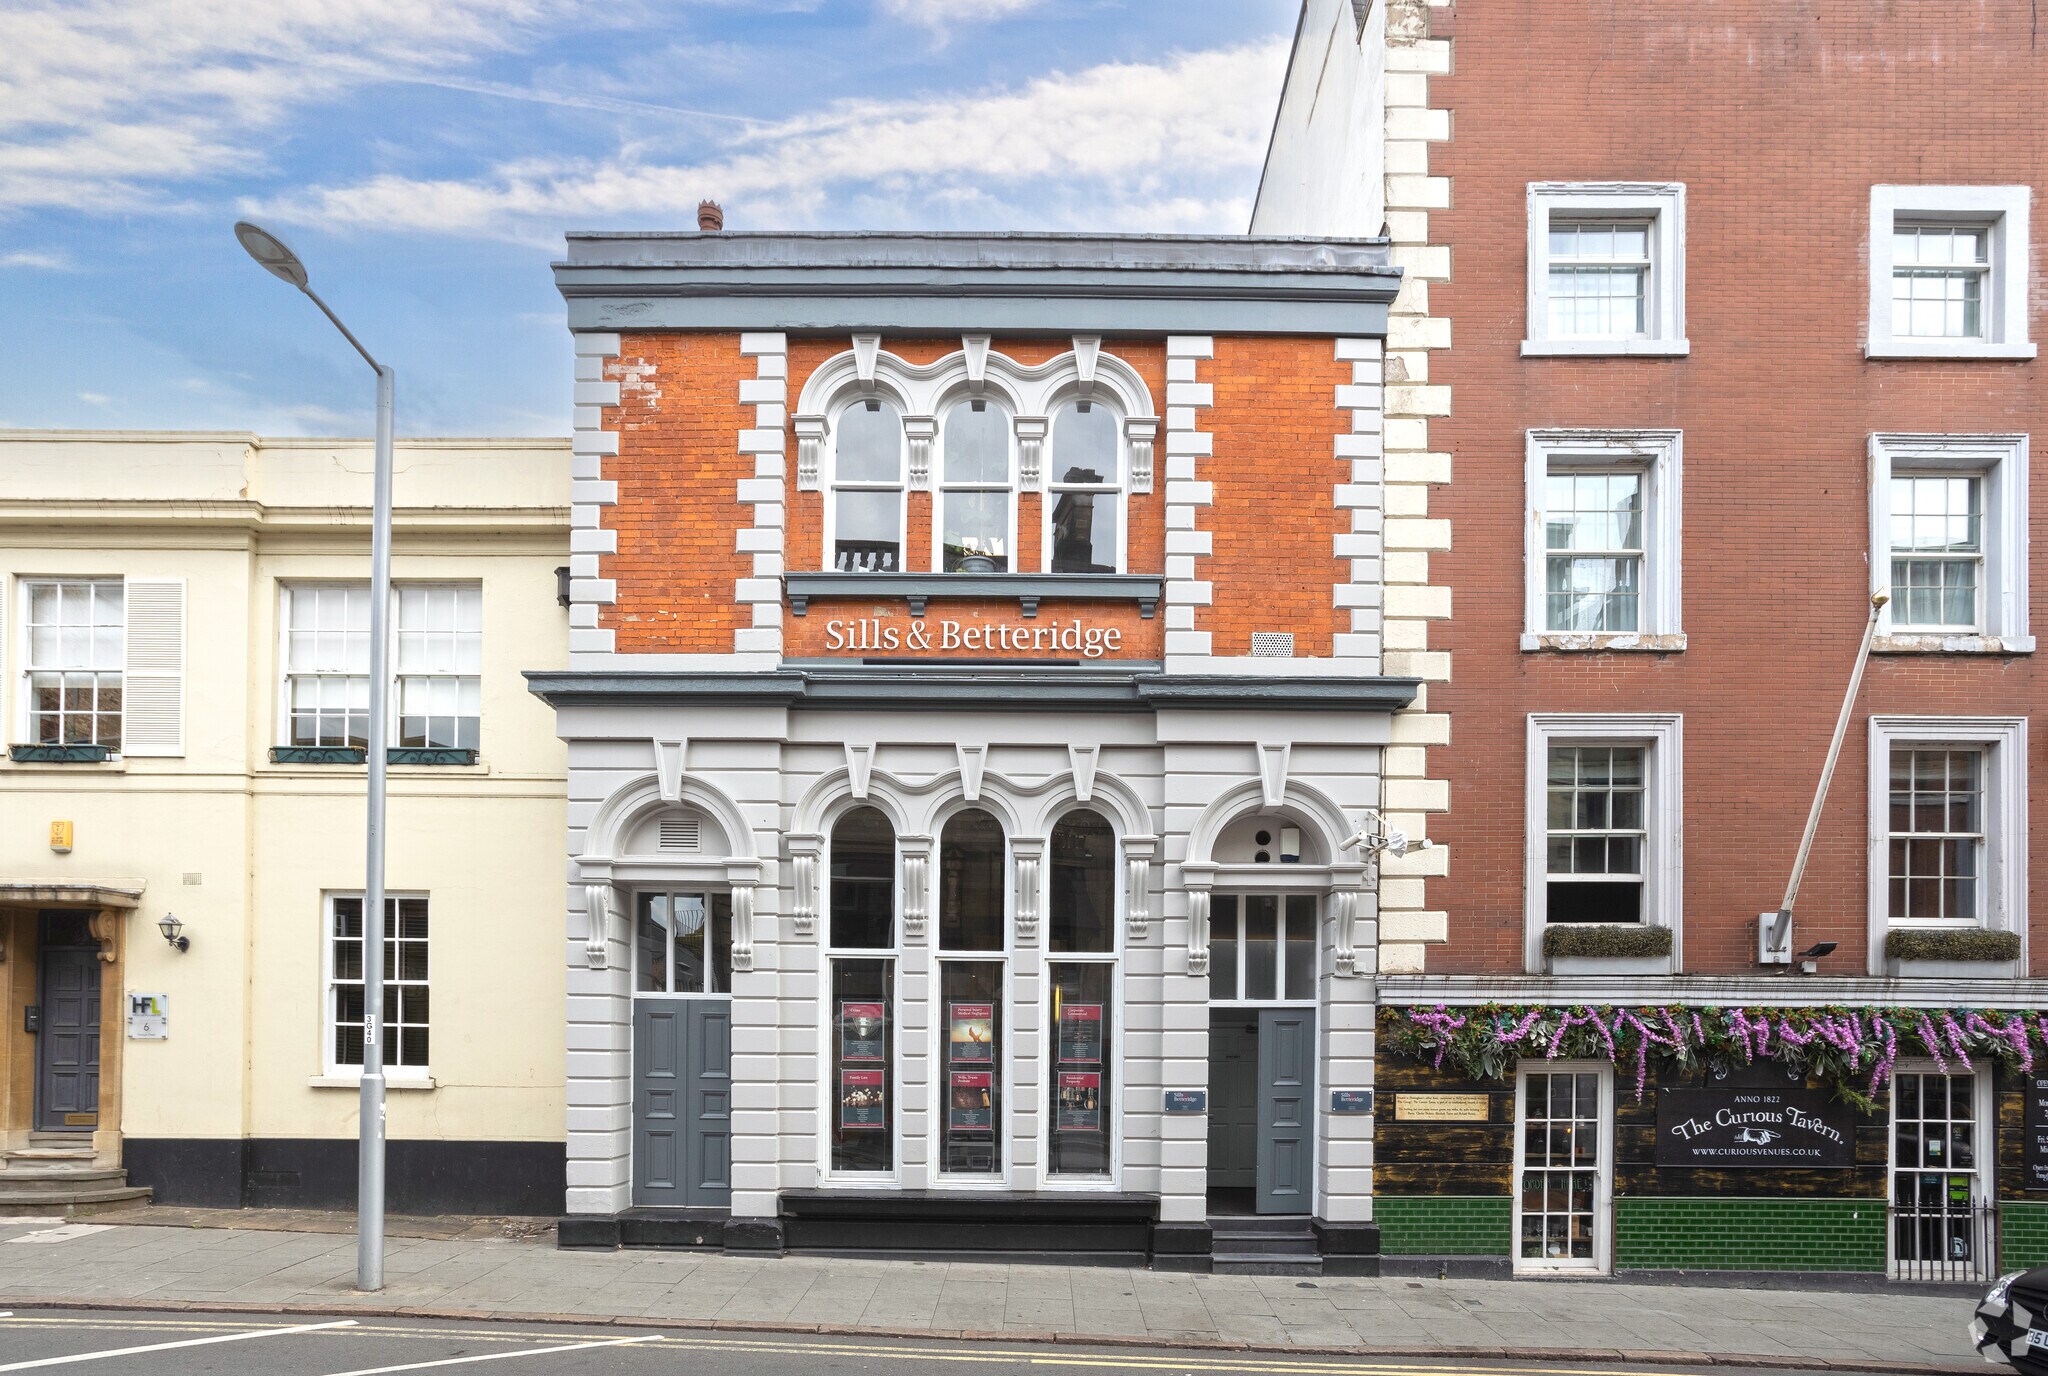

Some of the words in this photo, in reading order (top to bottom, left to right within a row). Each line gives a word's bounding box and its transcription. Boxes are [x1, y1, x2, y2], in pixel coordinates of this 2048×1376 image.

[826, 618, 899, 650] Sills
[906, 620, 932, 650] &
[940, 619, 1122, 657] Betteridge
[132, 997, 161, 1014] HFL
[144, 1022, 149, 1031] 6
[1734, 1095, 1760, 1103] ANNO
[1763, 1095, 1780, 1103] 1822
[1672, 1118, 1713, 1140] The
[1715, 1108, 1783, 1127] Curious
[1692, 1148, 1821, 1157] WWW.CURIOUSVENUES.CO.UK
